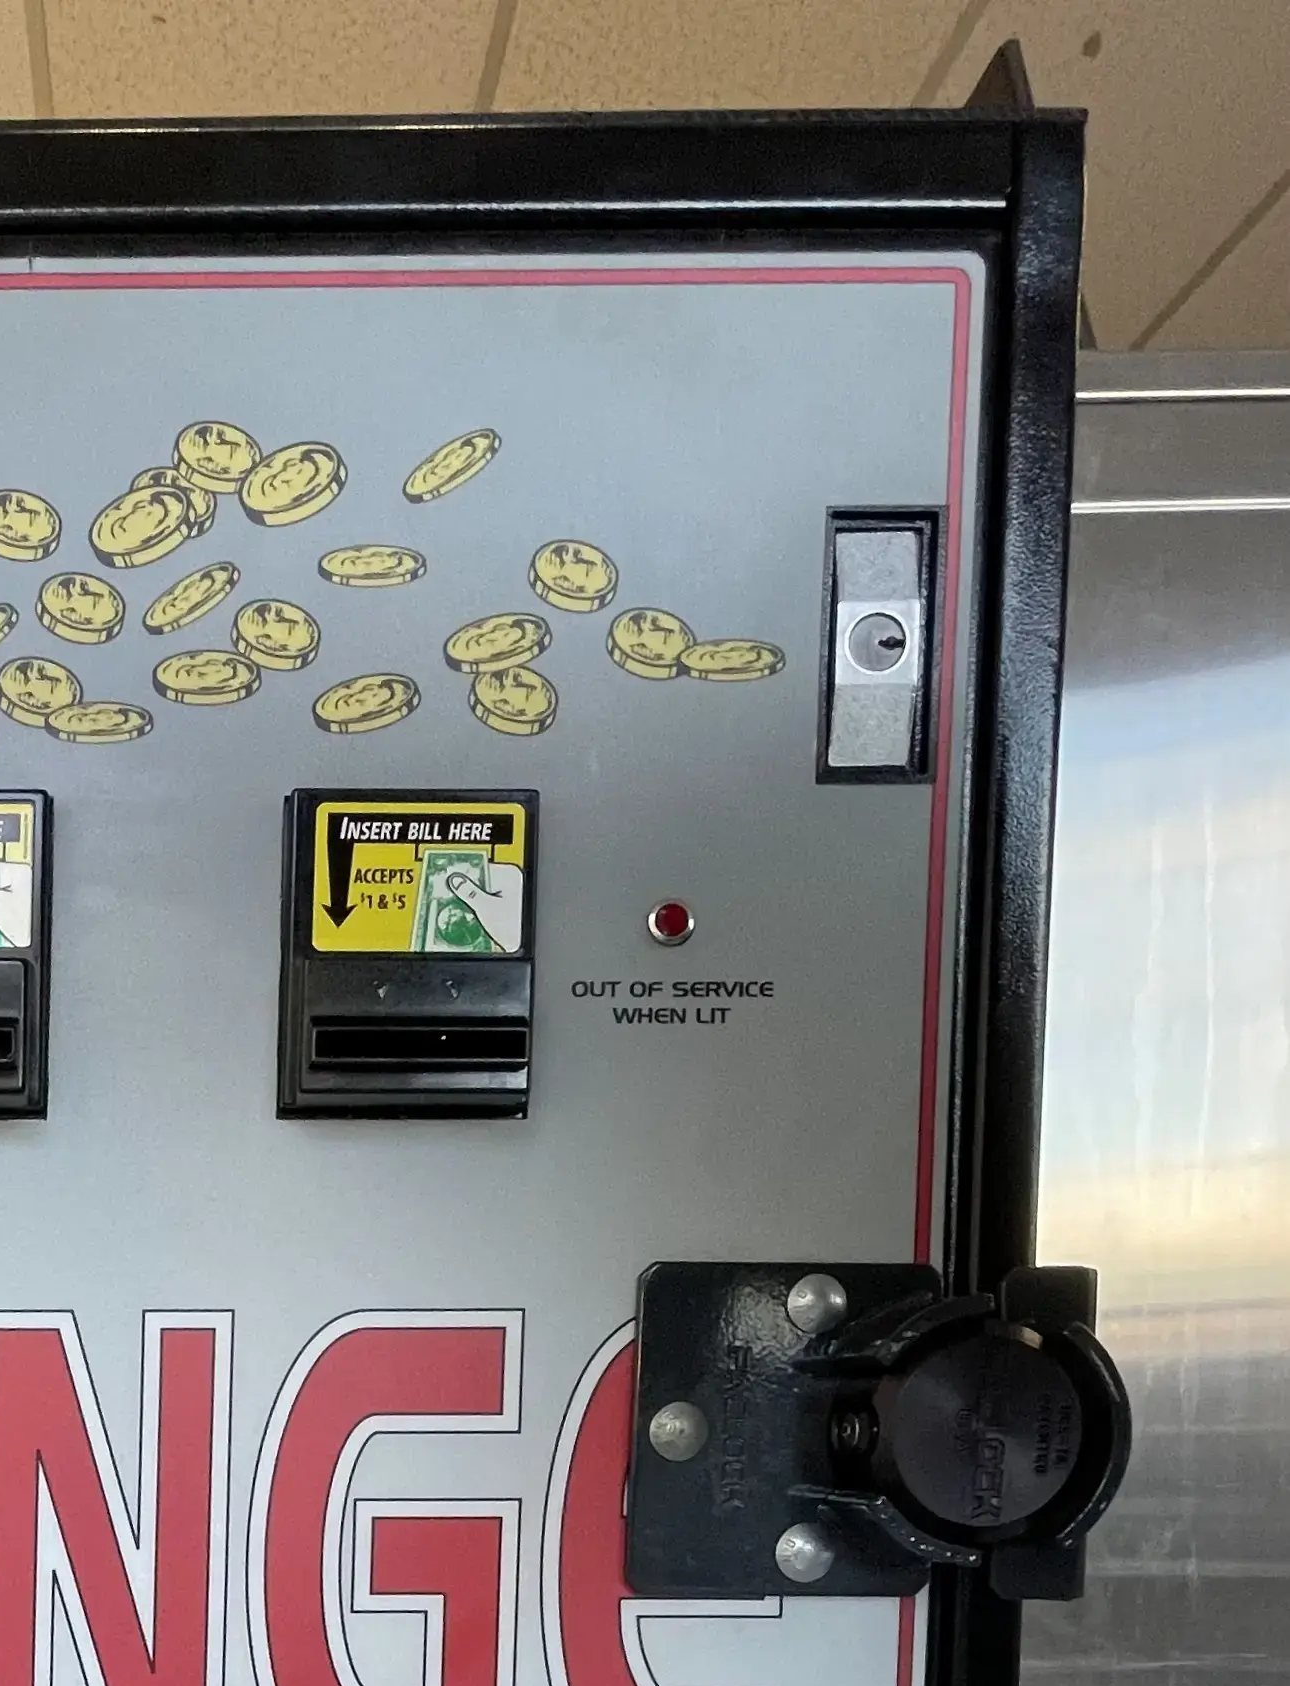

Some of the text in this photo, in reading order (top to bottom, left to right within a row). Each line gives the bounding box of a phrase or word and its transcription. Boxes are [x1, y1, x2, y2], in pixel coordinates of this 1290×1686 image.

[340, 815, 493, 841] INSERT BILL HERE
[353, 868, 414, 885] ACCEPTS
[377, 894, 389, 910] &
[392, 894, 406, 910] $5
[571, 981, 775, 998] OUT OF SERVICE
[613, 1007, 732, 1025] WHEN LIT
